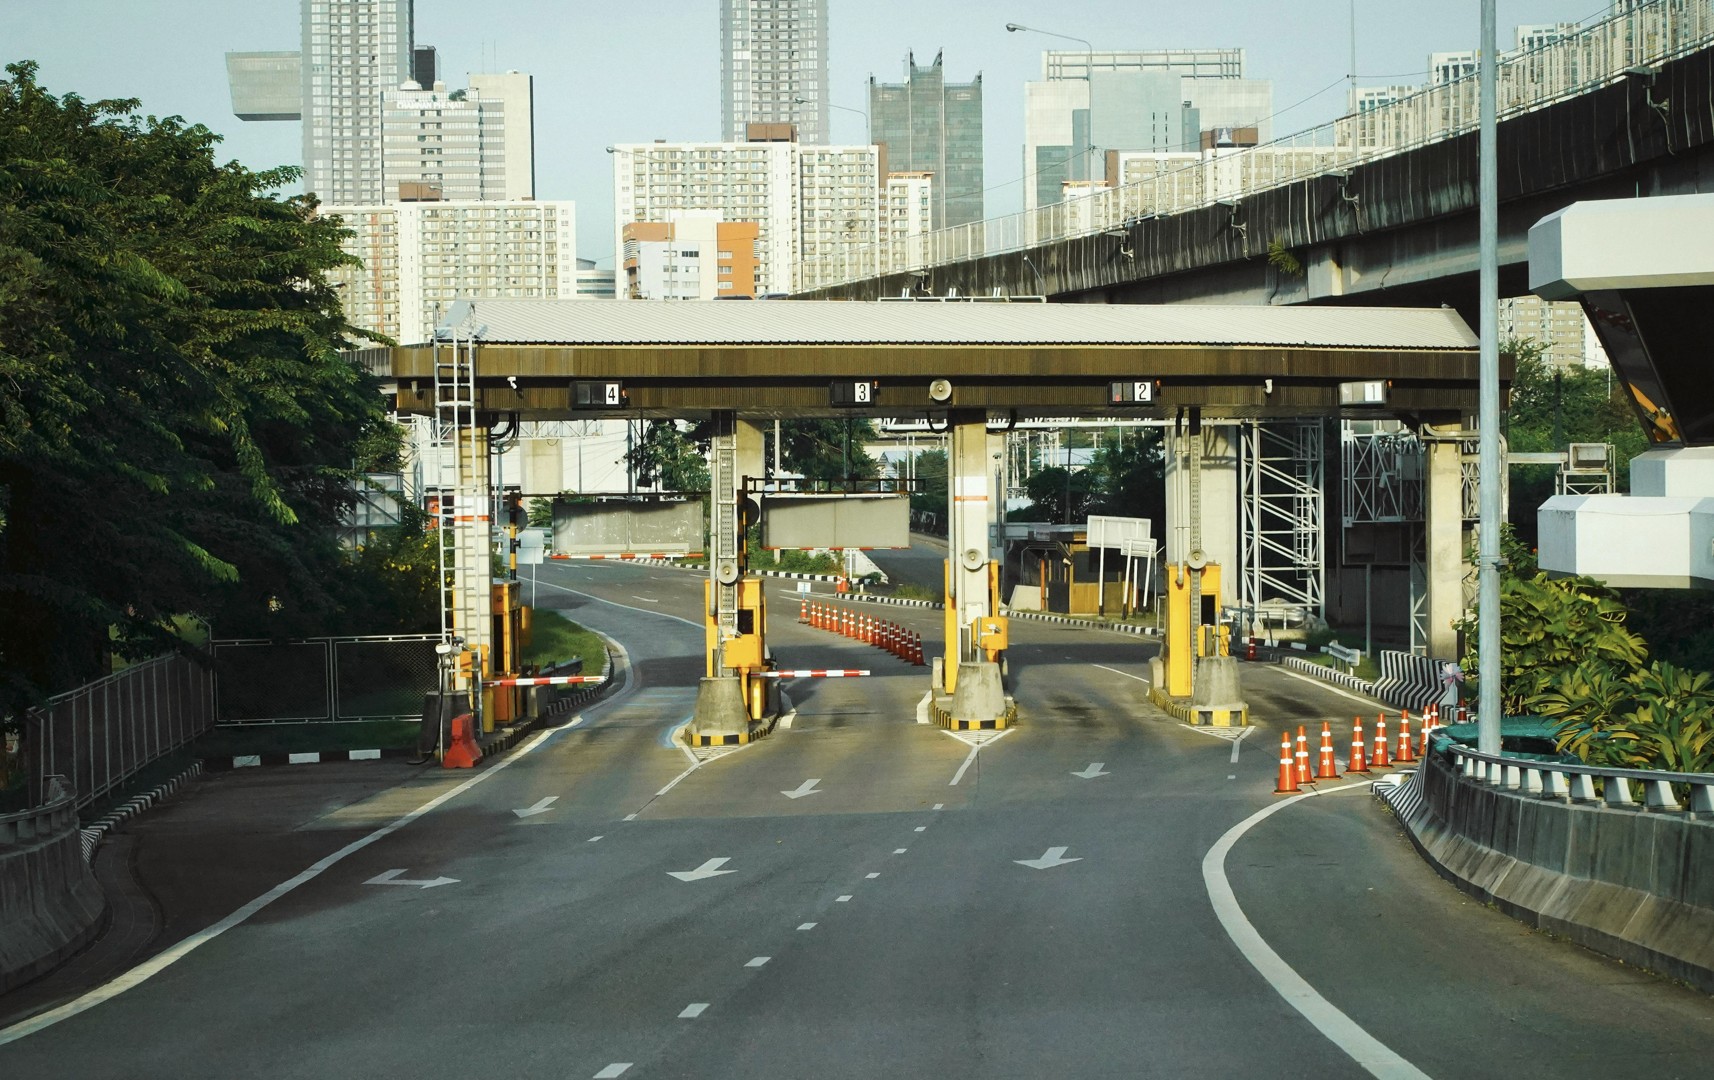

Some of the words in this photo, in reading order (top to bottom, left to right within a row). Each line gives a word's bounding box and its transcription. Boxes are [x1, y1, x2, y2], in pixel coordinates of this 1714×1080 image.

[608, 387, 615, 401] 4
[858, 383, 866, 401] 3
[1138, 383, 1147, 400] 2
